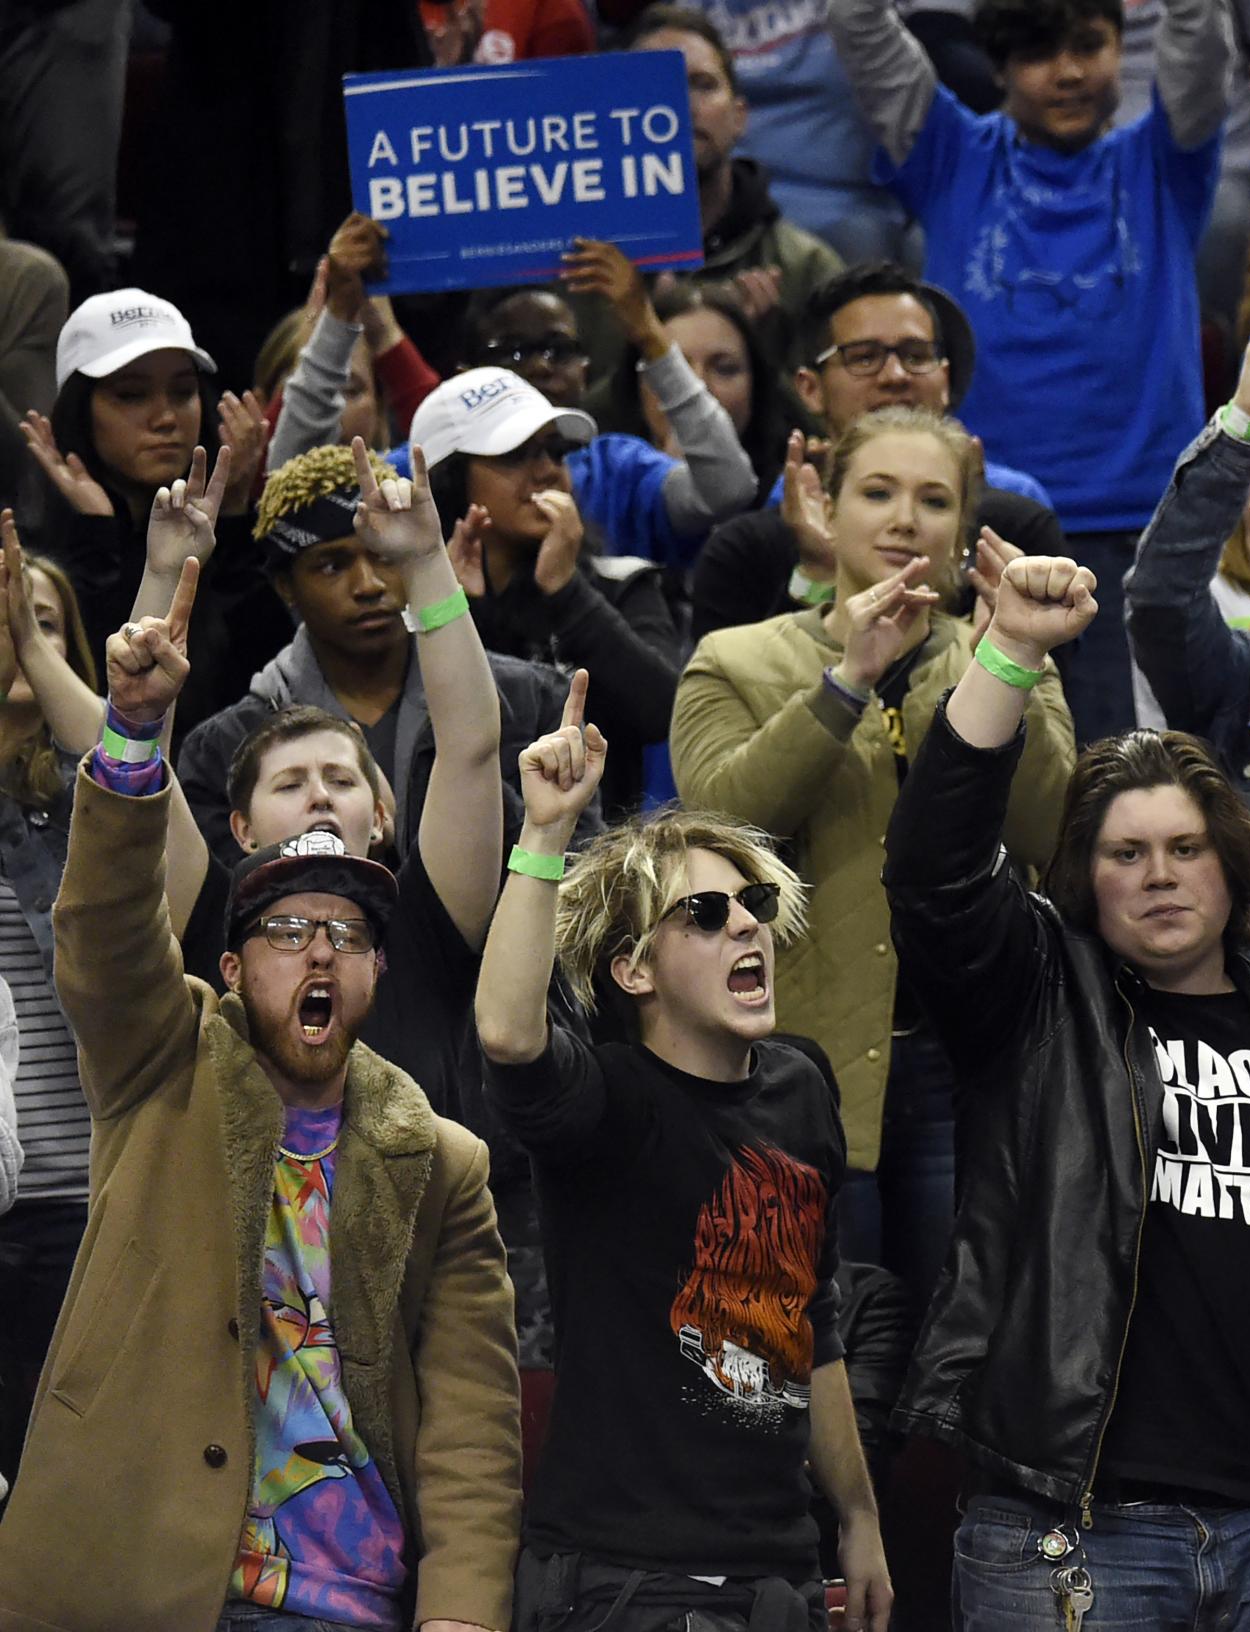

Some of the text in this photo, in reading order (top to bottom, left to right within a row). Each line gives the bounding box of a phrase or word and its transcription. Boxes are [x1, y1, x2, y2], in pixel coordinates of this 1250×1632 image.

[368, 105, 679, 168] A FUTURE TO
[368, 152, 686, 221] BELIEVE IN
